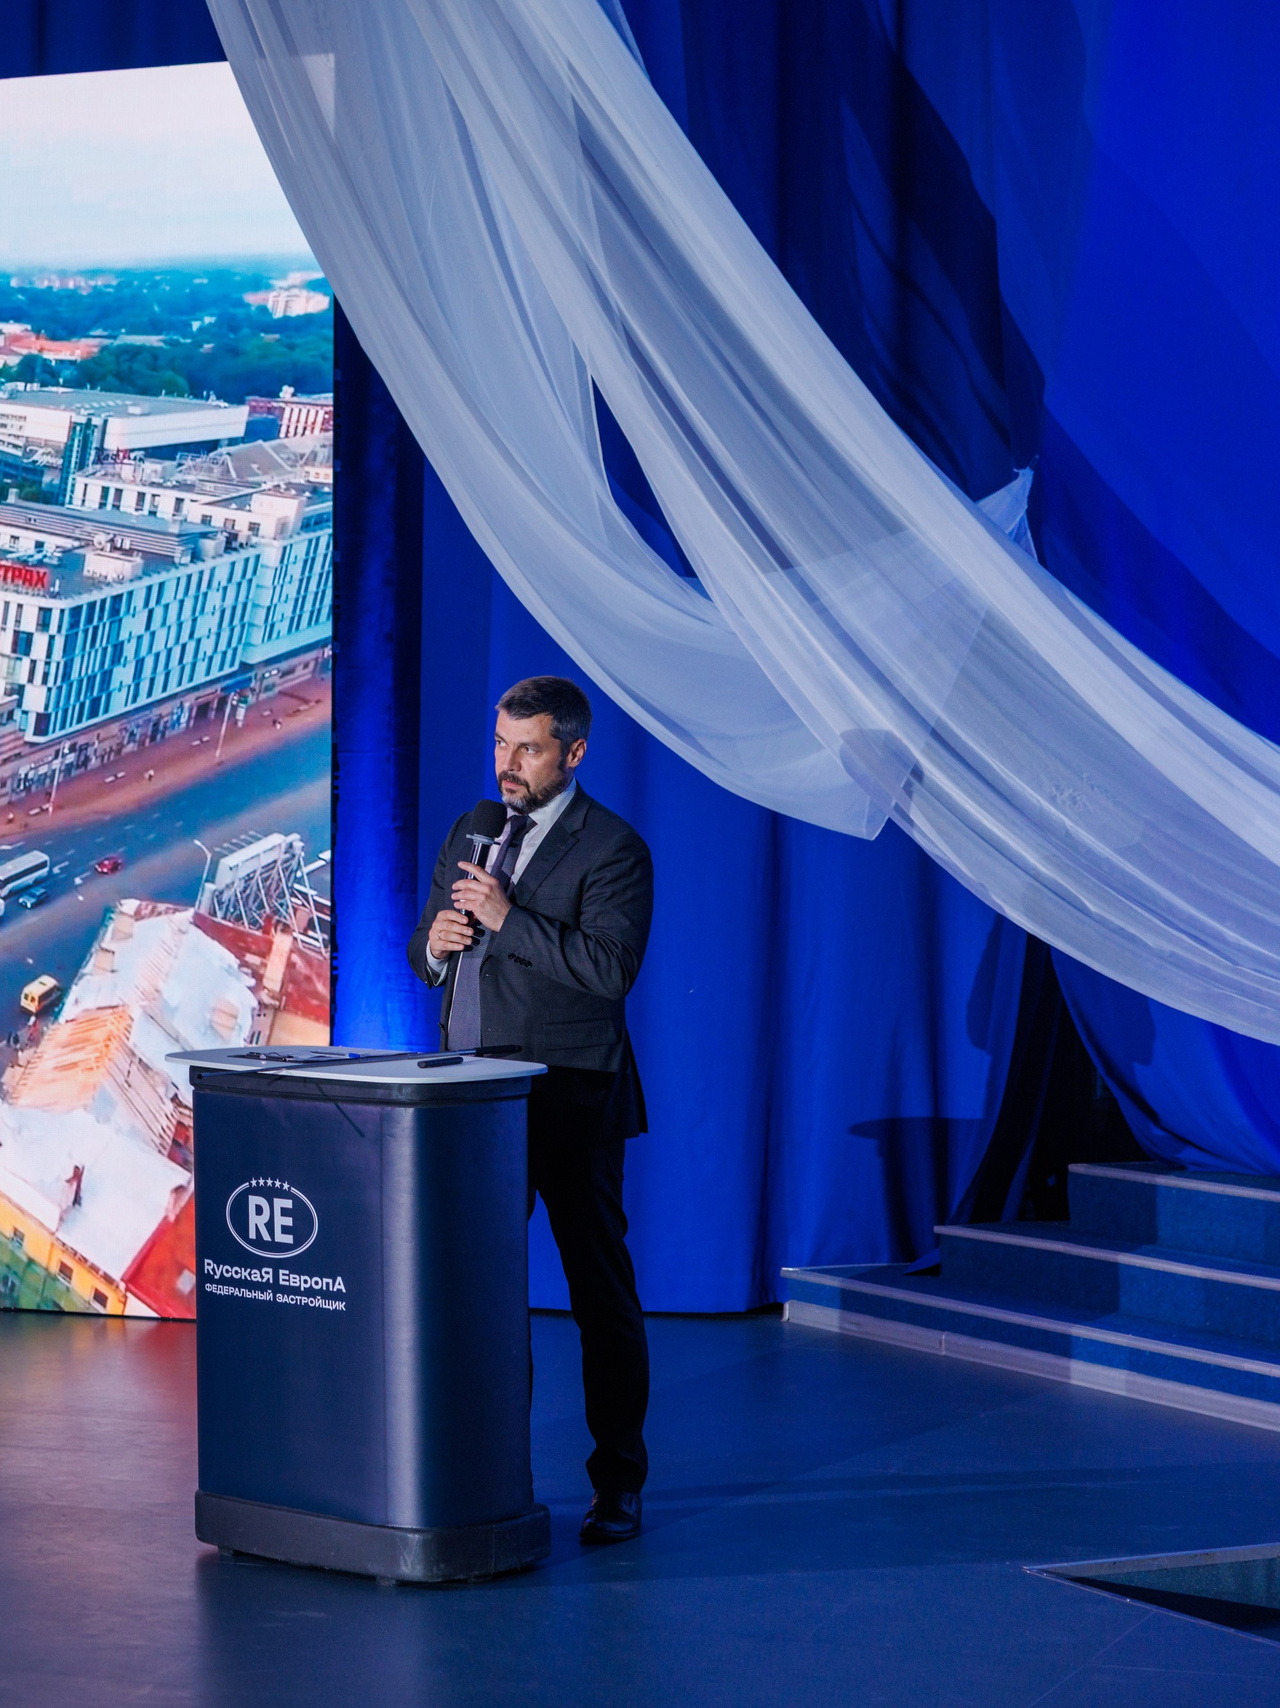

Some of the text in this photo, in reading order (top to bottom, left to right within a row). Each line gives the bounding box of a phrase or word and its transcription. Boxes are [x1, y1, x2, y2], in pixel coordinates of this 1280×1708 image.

[248, 1194, 294, 1245] RE
[278, 1269, 347, 1293] ЕвропА
[204, 1282, 346, 1312] ФЕДЕРАЛЬНЫЙ ЗАСТРОЙЩИК
